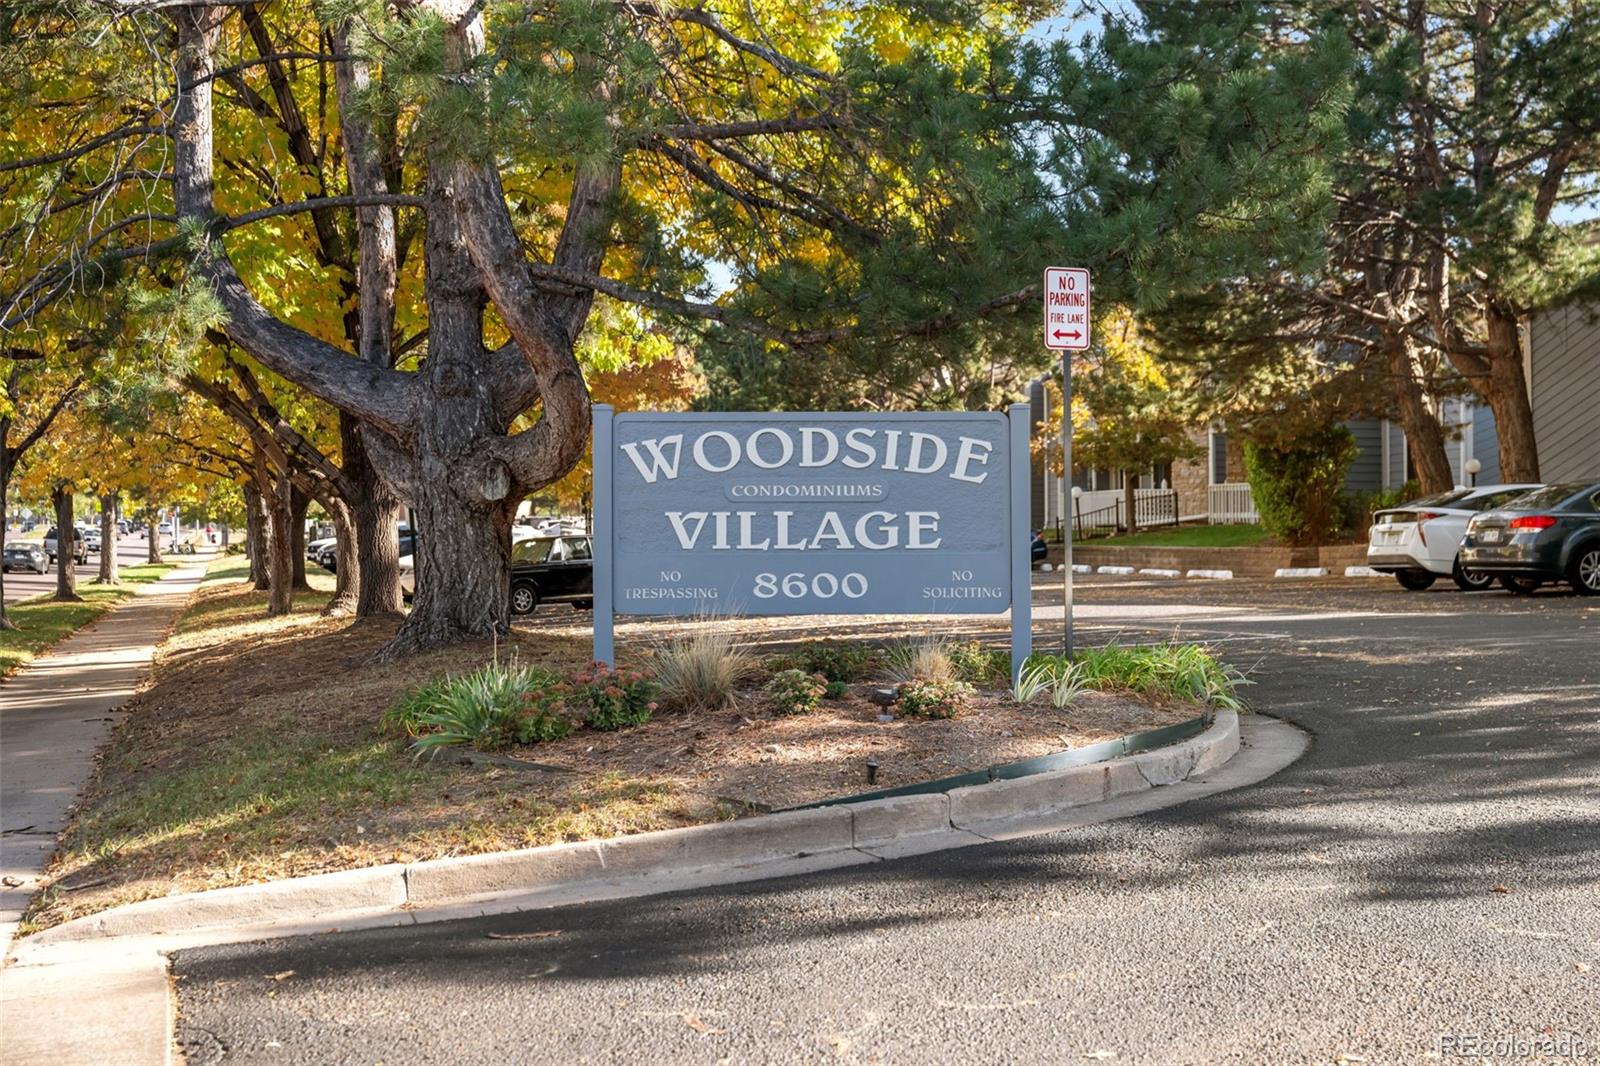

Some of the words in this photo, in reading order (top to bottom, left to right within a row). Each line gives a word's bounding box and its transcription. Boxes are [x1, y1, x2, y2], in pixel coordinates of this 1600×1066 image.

[1059, 276, 1075, 290] NO
[1049, 292, 1085, 307] PARKING
[1050, 312, 1065, 323] FIRE
[1067, 313, 1084, 324] LANE
[620, 427, 993, 484] WOODSIDE
[731, 484, 883, 497] CONDOMINIUMS
[665, 511, 942, 551] VILLAGE
[660, 570, 682, 582] NO
[952, 570, 973, 582] NO
[753, 572, 869, 599] 8600
[624, 587, 718, 600] TRESPASSING
[922, 586, 1002, 599] SOLICITING
